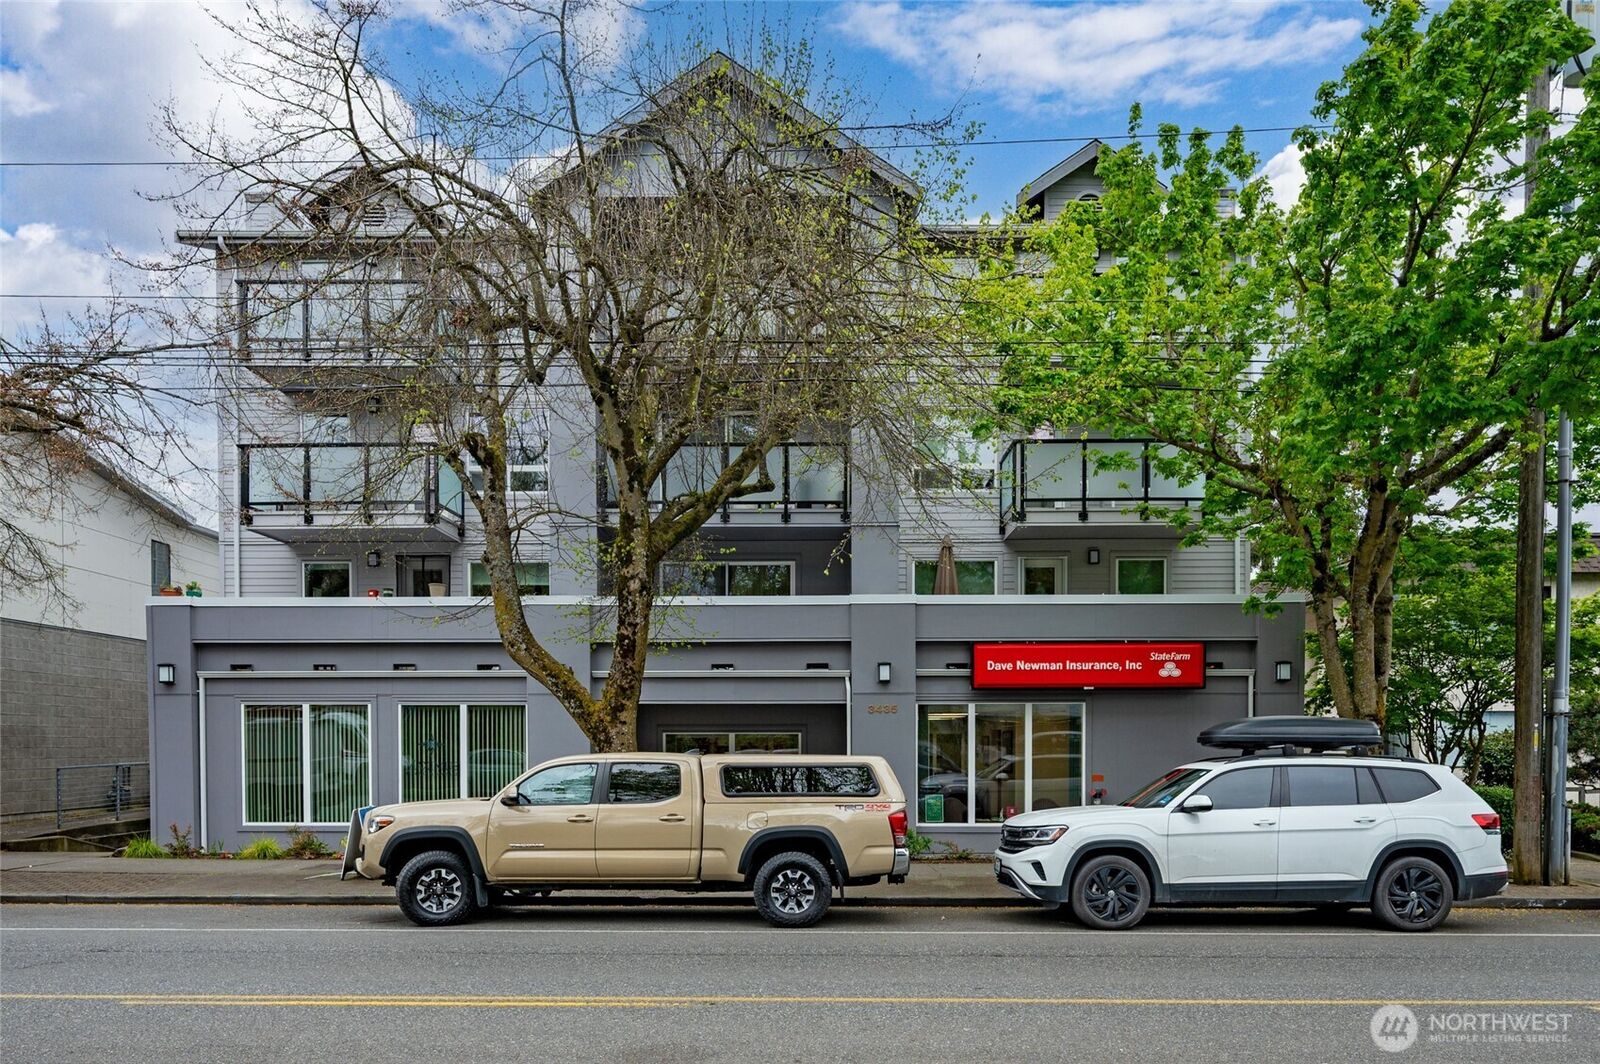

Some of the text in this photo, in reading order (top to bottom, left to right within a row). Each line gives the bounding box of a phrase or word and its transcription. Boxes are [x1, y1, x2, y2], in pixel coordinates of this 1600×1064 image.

[987, 660, 1142, 671] Dave Newman Insurance, Inc
